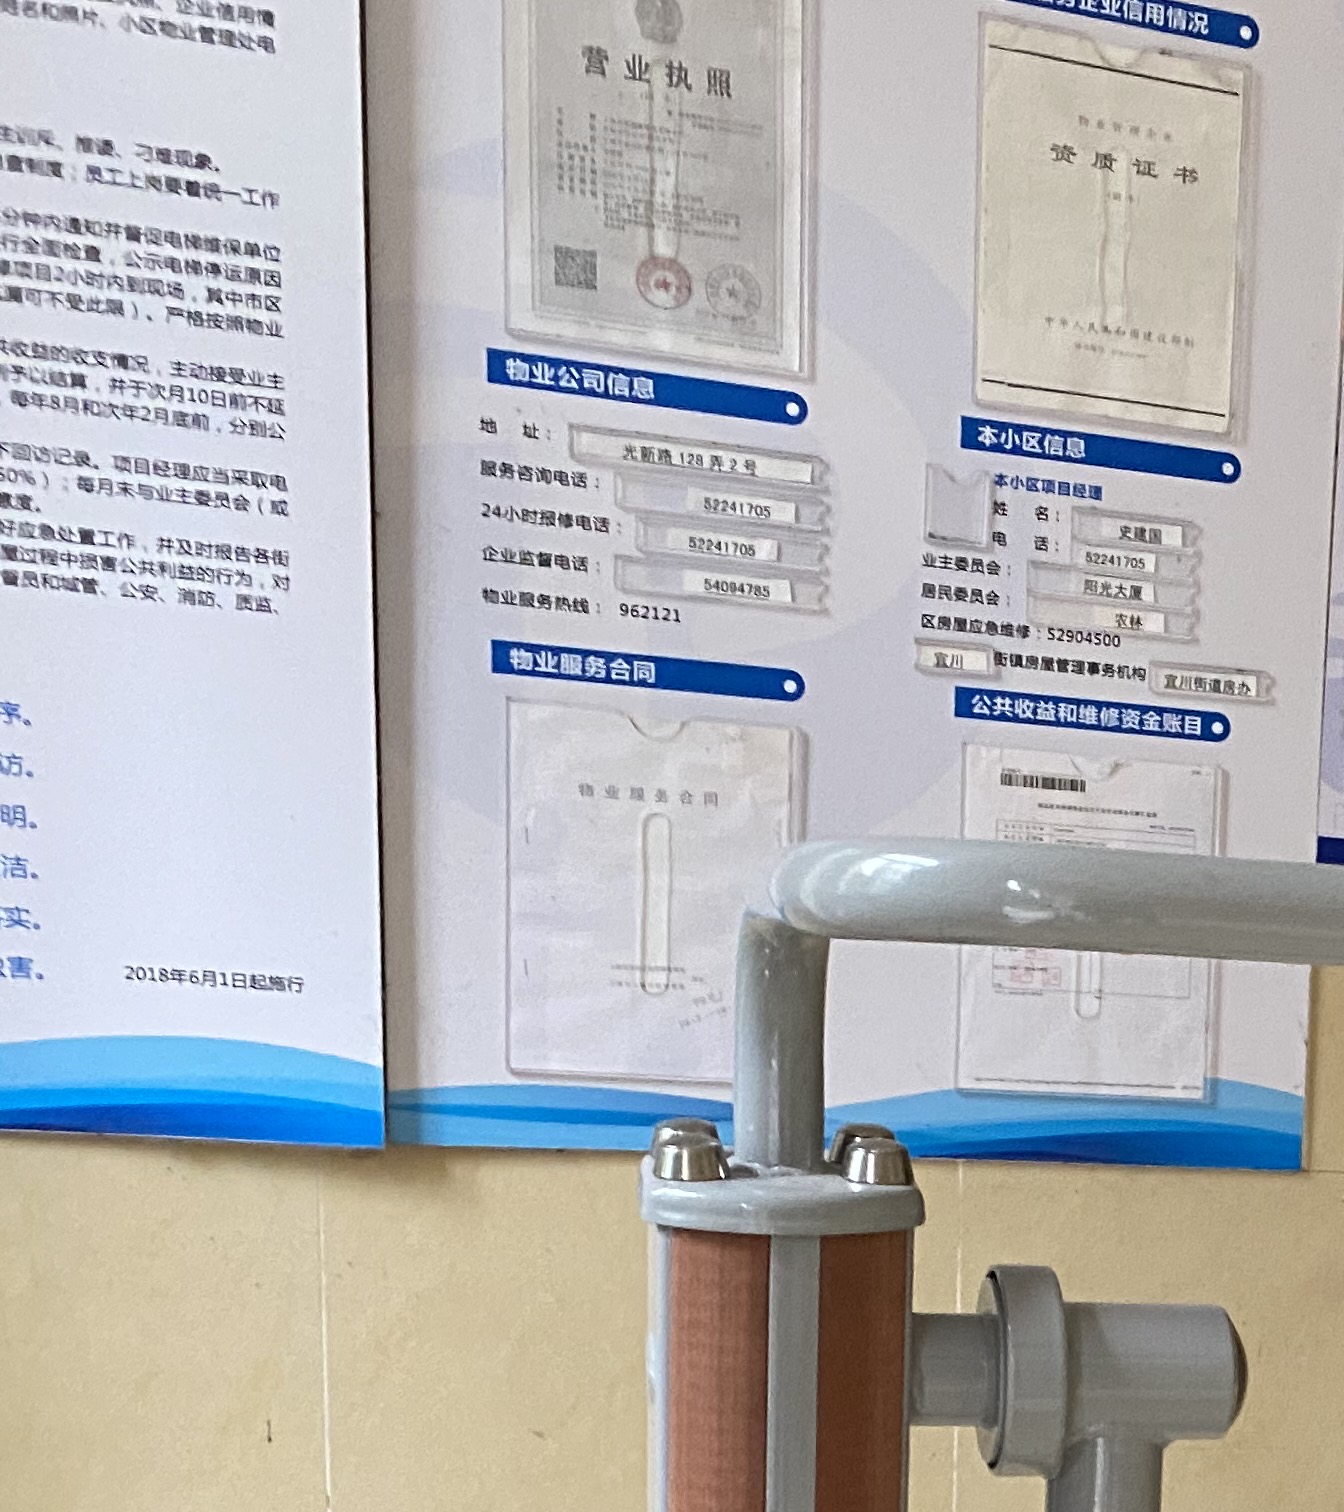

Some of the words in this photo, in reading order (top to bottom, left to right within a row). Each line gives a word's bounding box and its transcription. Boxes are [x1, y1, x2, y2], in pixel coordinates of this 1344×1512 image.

[581, 45, 732, 99] 营业执照
[1049, 142, 1199, 185] 资质证书
[505, 357, 656, 401] 物业公司信息
[977, 425, 1087, 459] 本小区信息
[480, 458, 600, 490] 服务咨询电话：
[994, 472, 1104, 502] 本小区项目经理
[480, 502, 622, 534] 24小时报修电话：
[703, 496, 771, 519] 52241705
[482, 544, 601, 573] 企业监督电话：
[688, 536, 756, 558] 52241705
[1085, 551, 1147, 571] 52241705
[921, 552, 1012, 578] 业主委员会：
[920, 582, 1011, 607] 居民委员会：
[1083, 579, 1144, 601] 阳光大厦
[618, 602, 682, 624] 962121
[509, 647, 657, 684] 物业服务合同
[993, 649, 1148, 682] 街镇房屋管理事务机构
[971, 694, 1203, 734] 公共收益和维修资金账目
[0, 804, 37, 829] 明。
[0, 906, 41, 930] 实。
[0, 956, 44, 981] 害。
[124, 965, 304, 993] 2018年6月1日起施行
